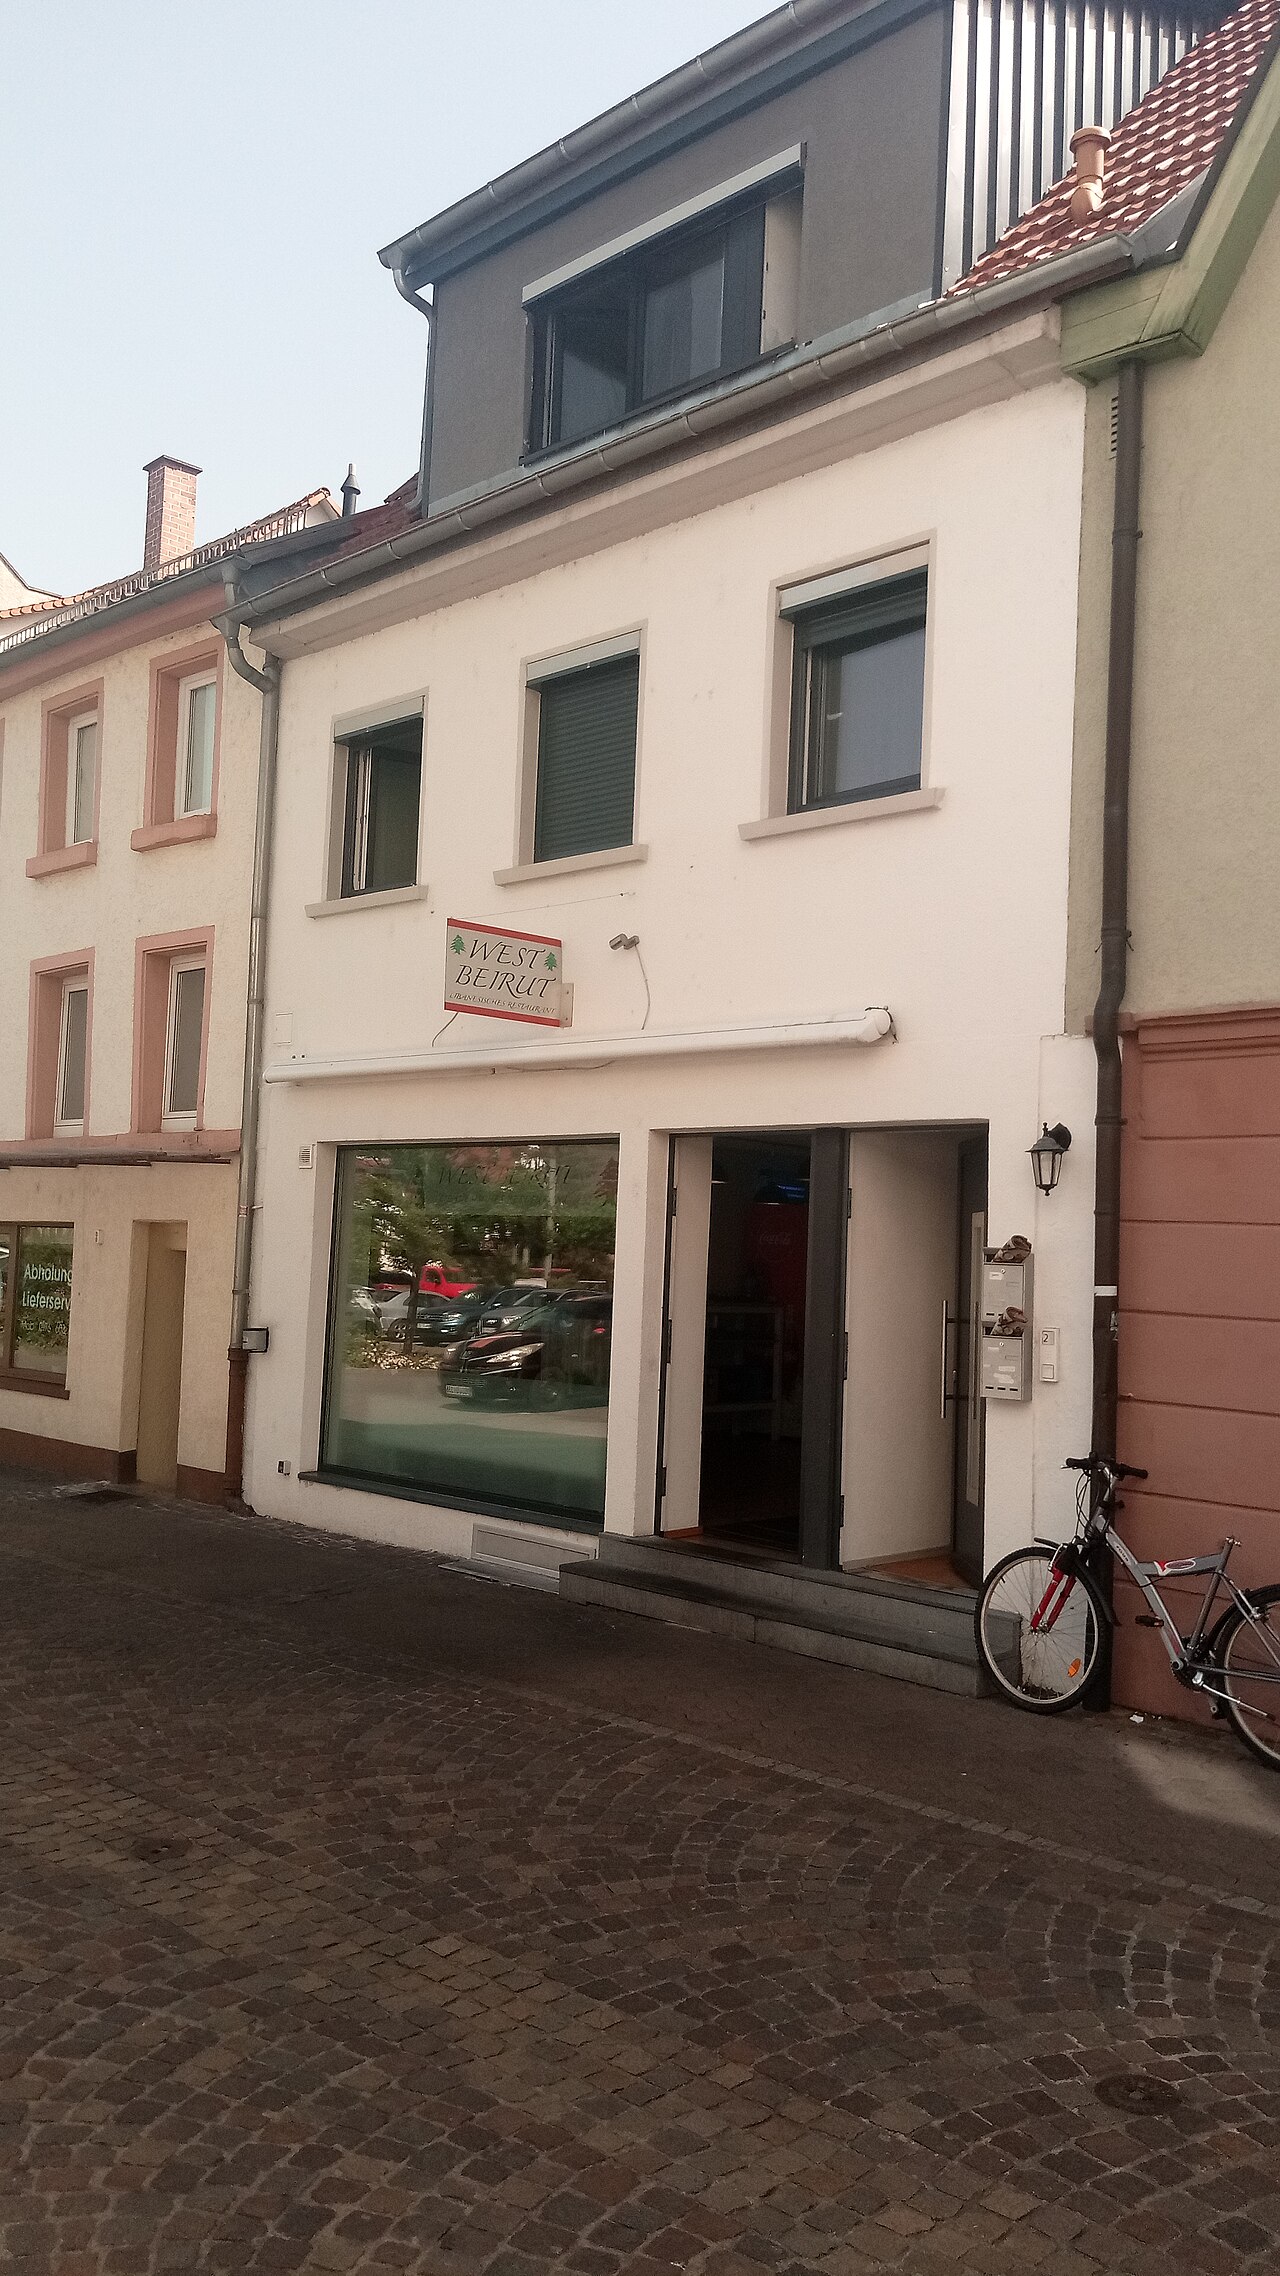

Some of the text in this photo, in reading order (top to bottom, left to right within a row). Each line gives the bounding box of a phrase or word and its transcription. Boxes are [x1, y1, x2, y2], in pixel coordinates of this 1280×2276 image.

[469, 939, 546, 969] WEST
[455, 964, 557, 999] BEIRUT
[449, 992, 556, 1014] LIBANESISCHES RESTAURANT
[24, 1263, 73, 1286] Abholung
